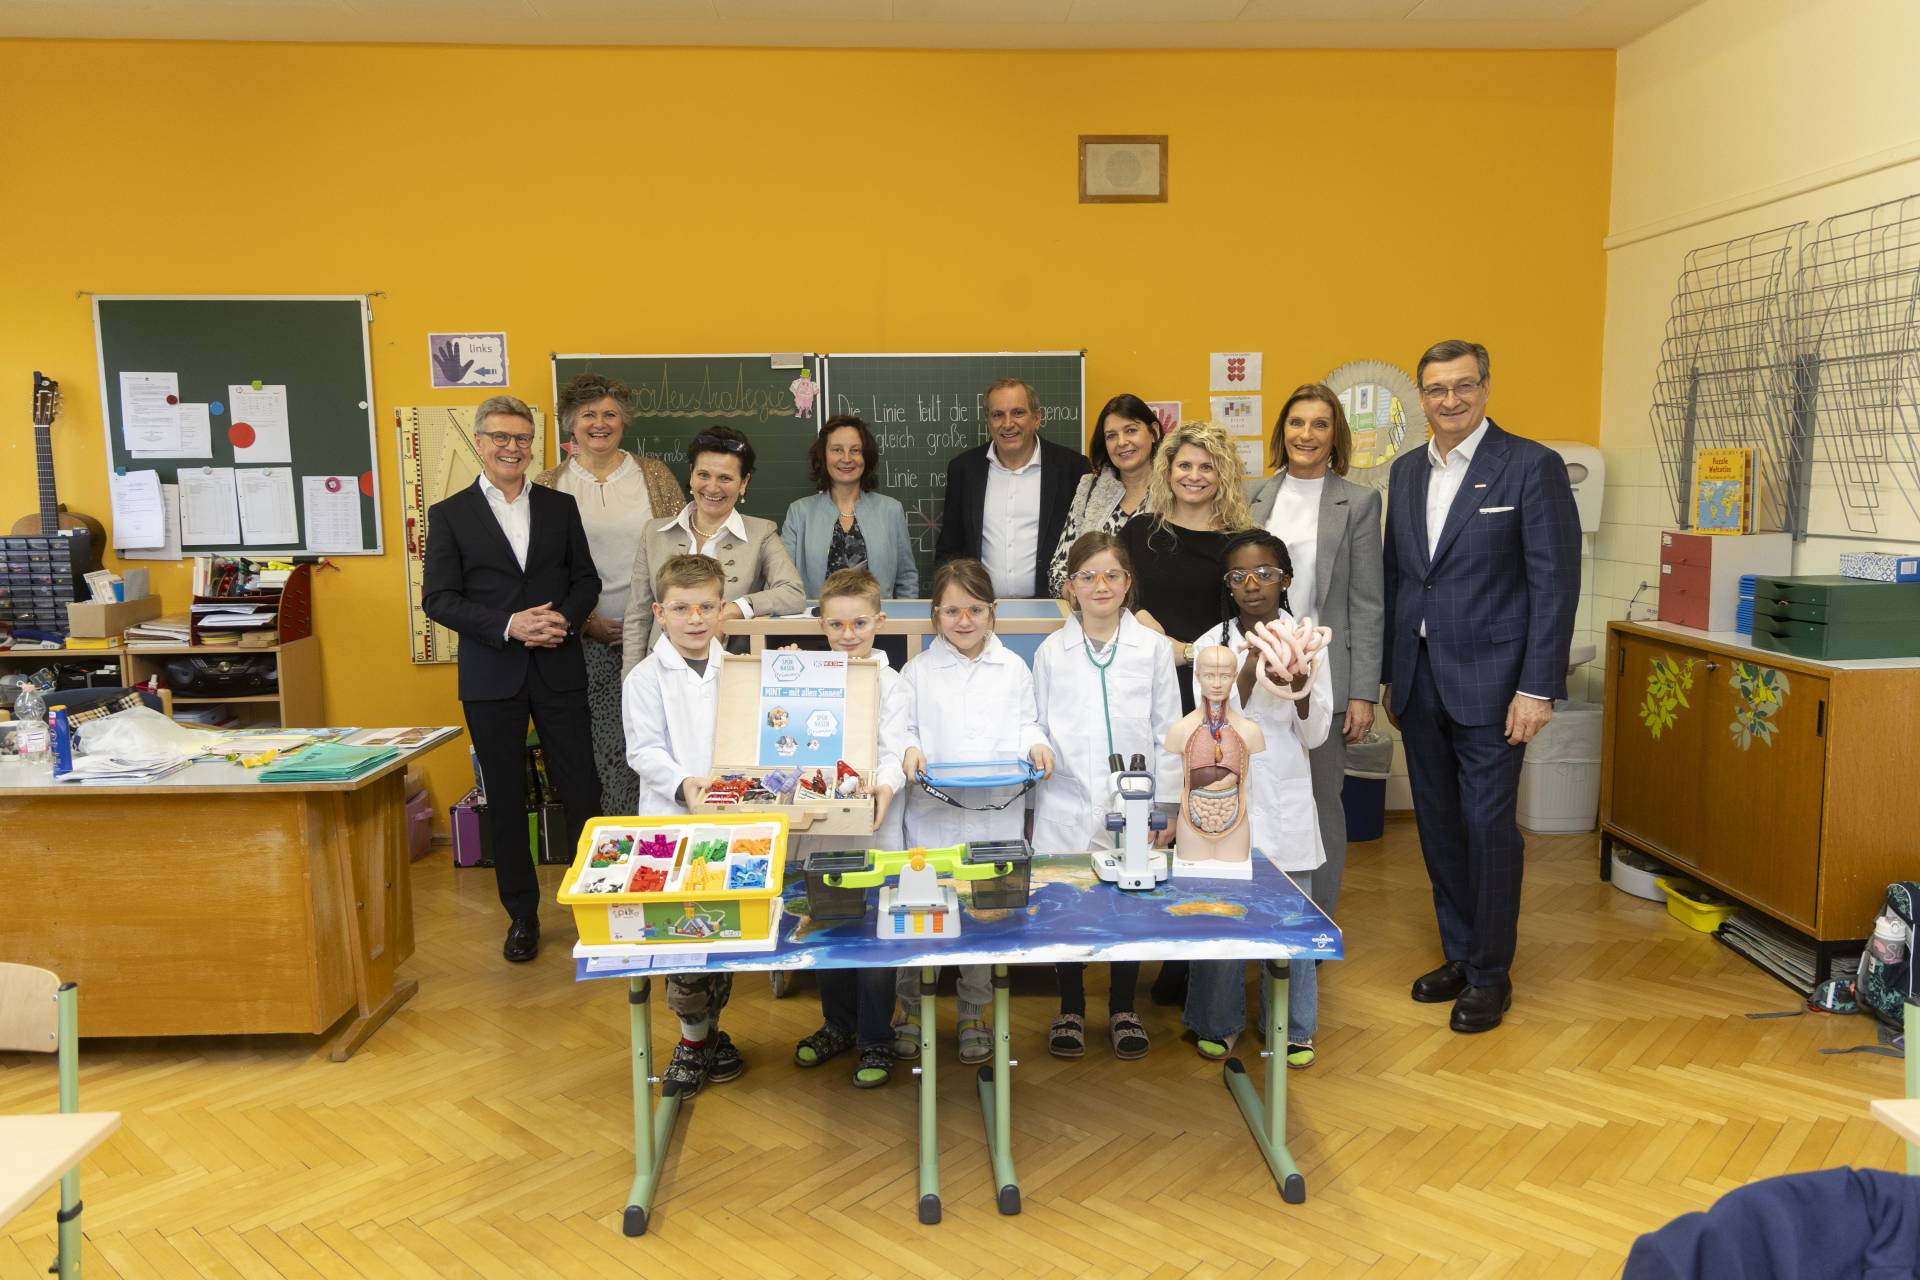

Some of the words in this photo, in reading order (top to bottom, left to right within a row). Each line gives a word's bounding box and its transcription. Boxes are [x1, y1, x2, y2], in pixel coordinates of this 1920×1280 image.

[469, 343, 493, 353] links
[838, 393, 861, 417] Die
[873, 394, 906, 423] Linie
[917, 393, 942, 422] teilt
[949, 393, 968, 422] die
[1038, 406, 1078, 427] genau
[876, 423, 915, 456] gleich
[927, 423, 968, 456] große
[885, 460, 919, 488] Linie
